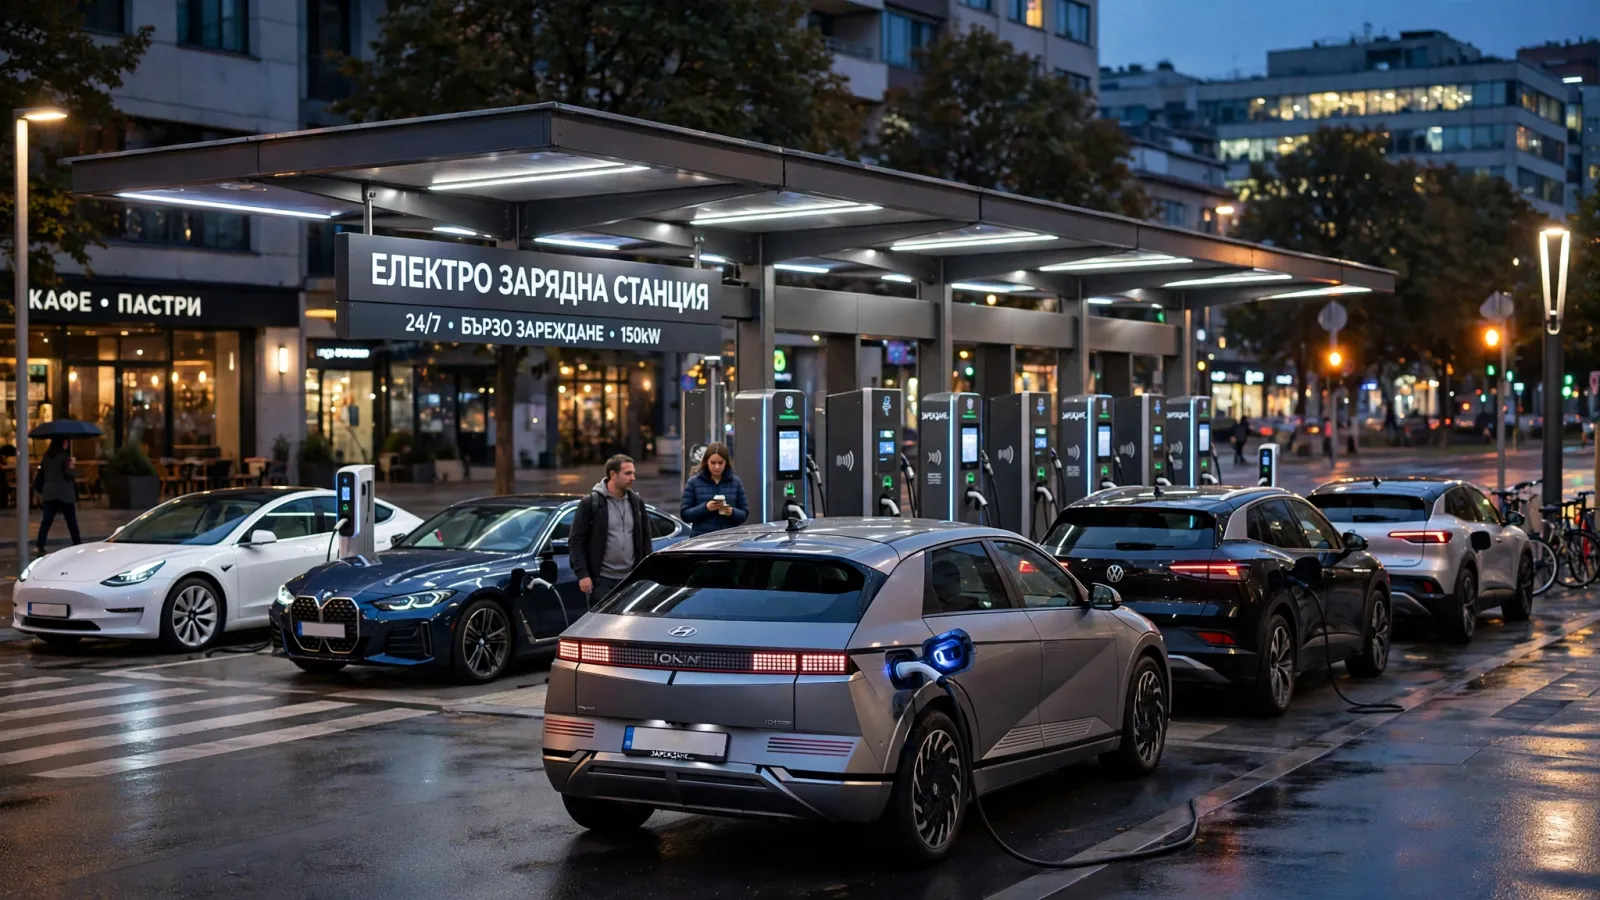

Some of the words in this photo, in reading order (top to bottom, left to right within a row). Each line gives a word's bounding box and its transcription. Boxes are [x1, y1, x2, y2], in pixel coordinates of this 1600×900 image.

[371, 251, 493, 294] ЕЛЕКТРО
[498, 264, 609, 307] ЗАРЯДНА
[613, 274, 710, 312] СТАНЦИЯ
[29, 288, 92, 312] КАФЕ
[117, 293, 202, 317] ПАСТРИ
[405, 312, 442, 335] 24/7
[461, 317, 513, 338] БЪРЗО
[515, 319, 605, 343] ЗАРЕЖДАНЕ
[620, 326, 661, 345] 150kW
